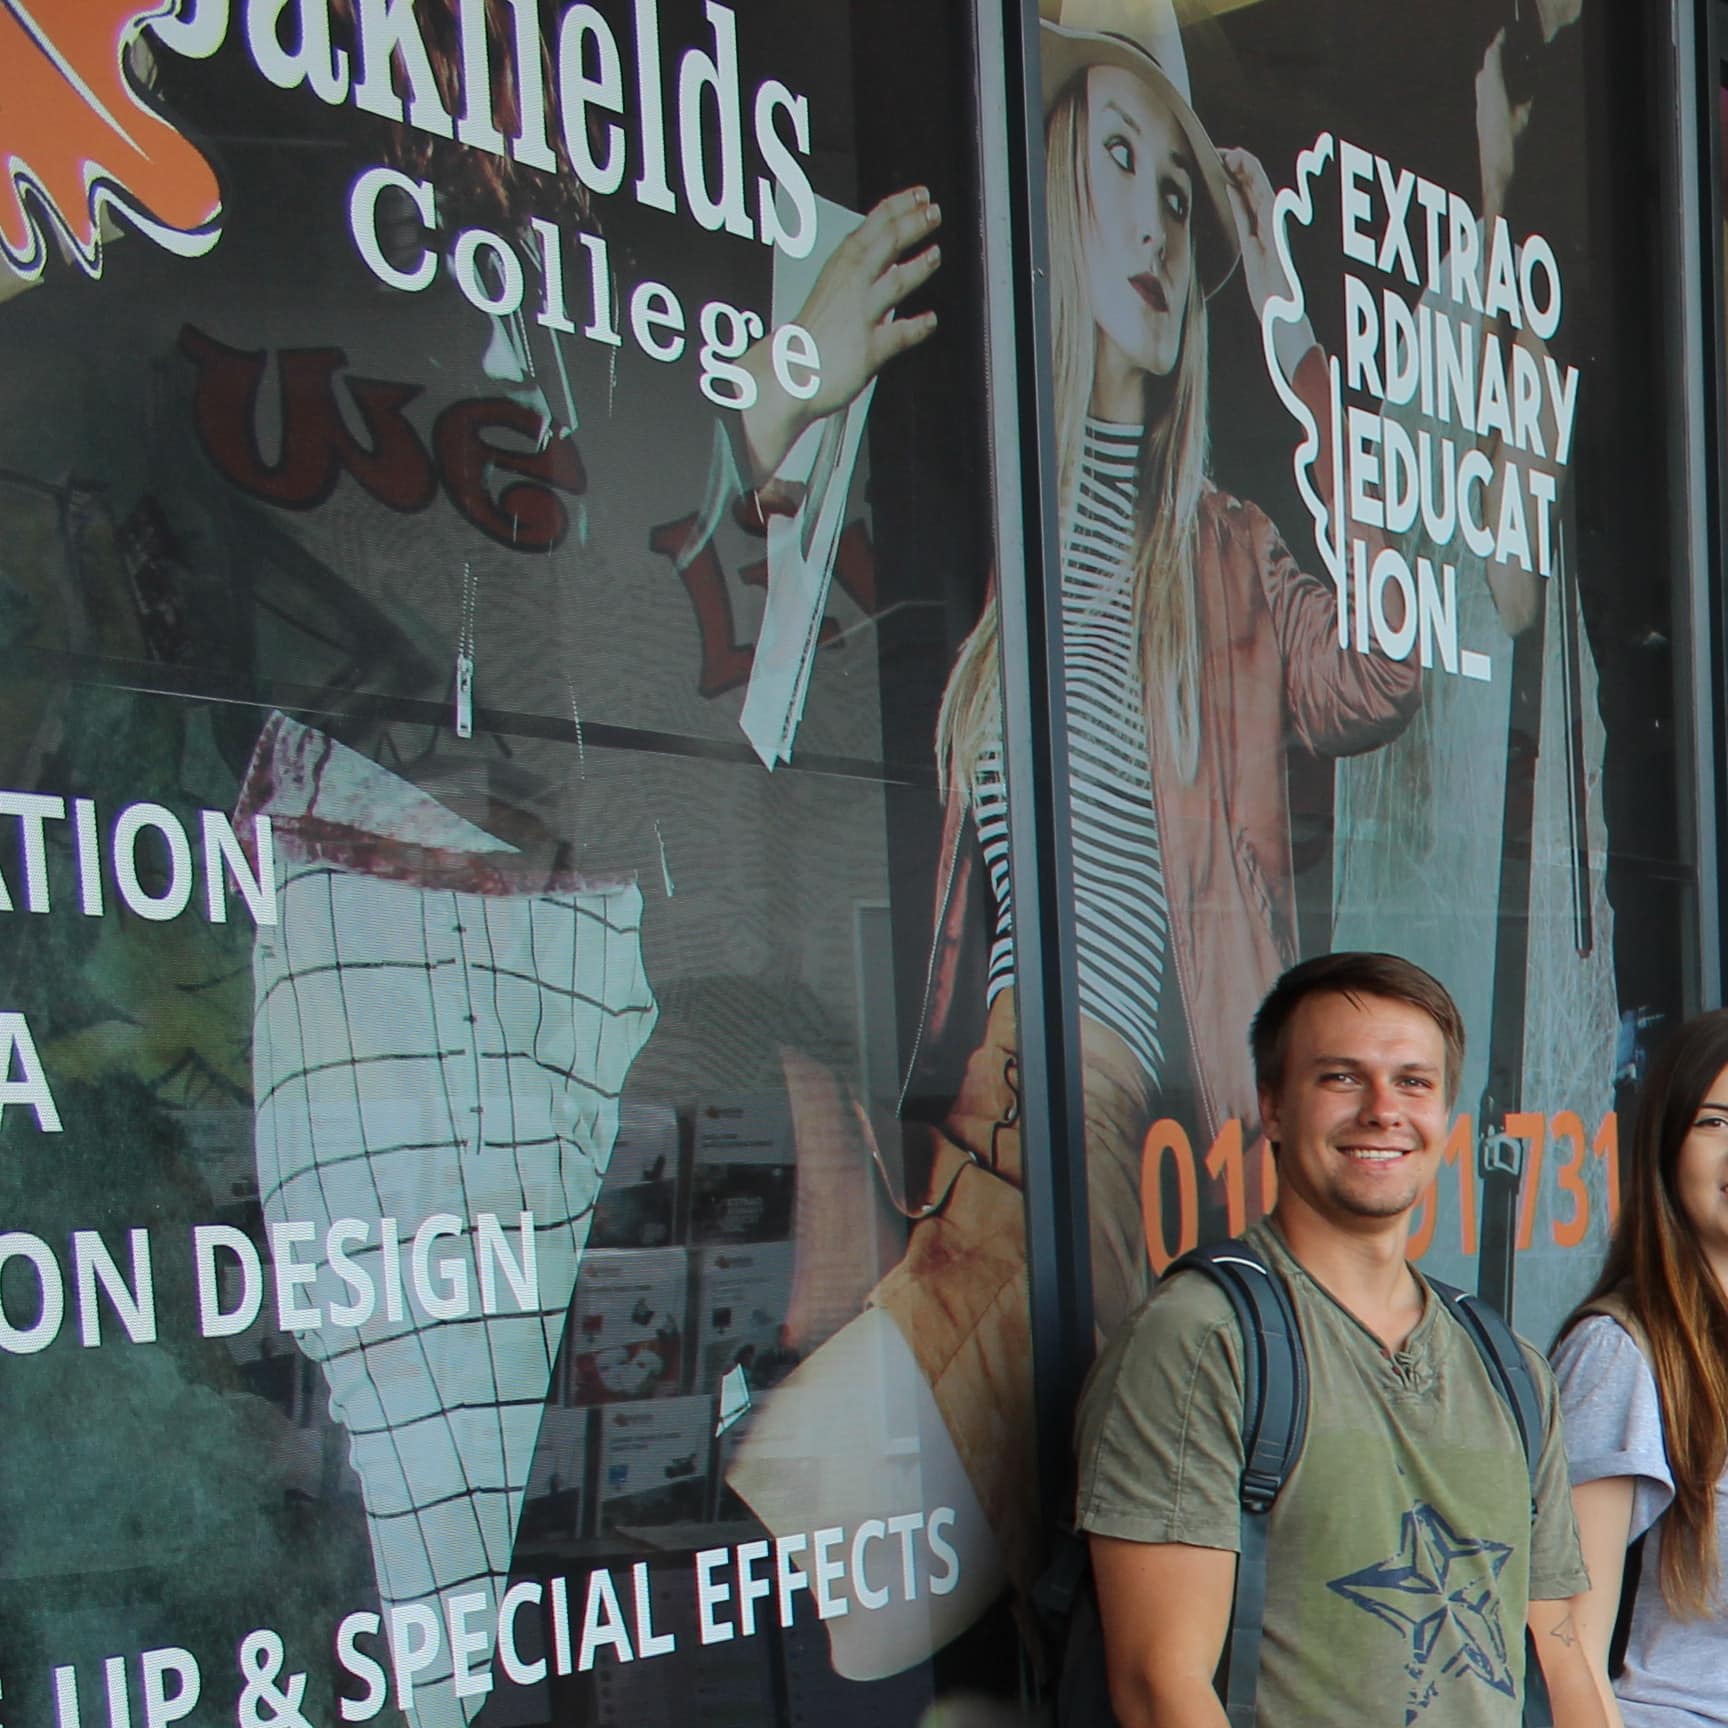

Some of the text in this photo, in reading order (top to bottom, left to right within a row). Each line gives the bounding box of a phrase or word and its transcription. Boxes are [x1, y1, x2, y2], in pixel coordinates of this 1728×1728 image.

[349, 166, 822, 410] College
[1339, 139, 1563, 340] EXTRAO
[1343, 273, 1579, 466] RDINARY
[1347, 405, 1556, 577] EDUCAT
[0, 791, 277, 926] TION
[195, 1210, 540, 1338] DESIGN
[336, 1561, 675, 1723] SPECIAL
[694, 1506, 962, 1647] EFFECTS
